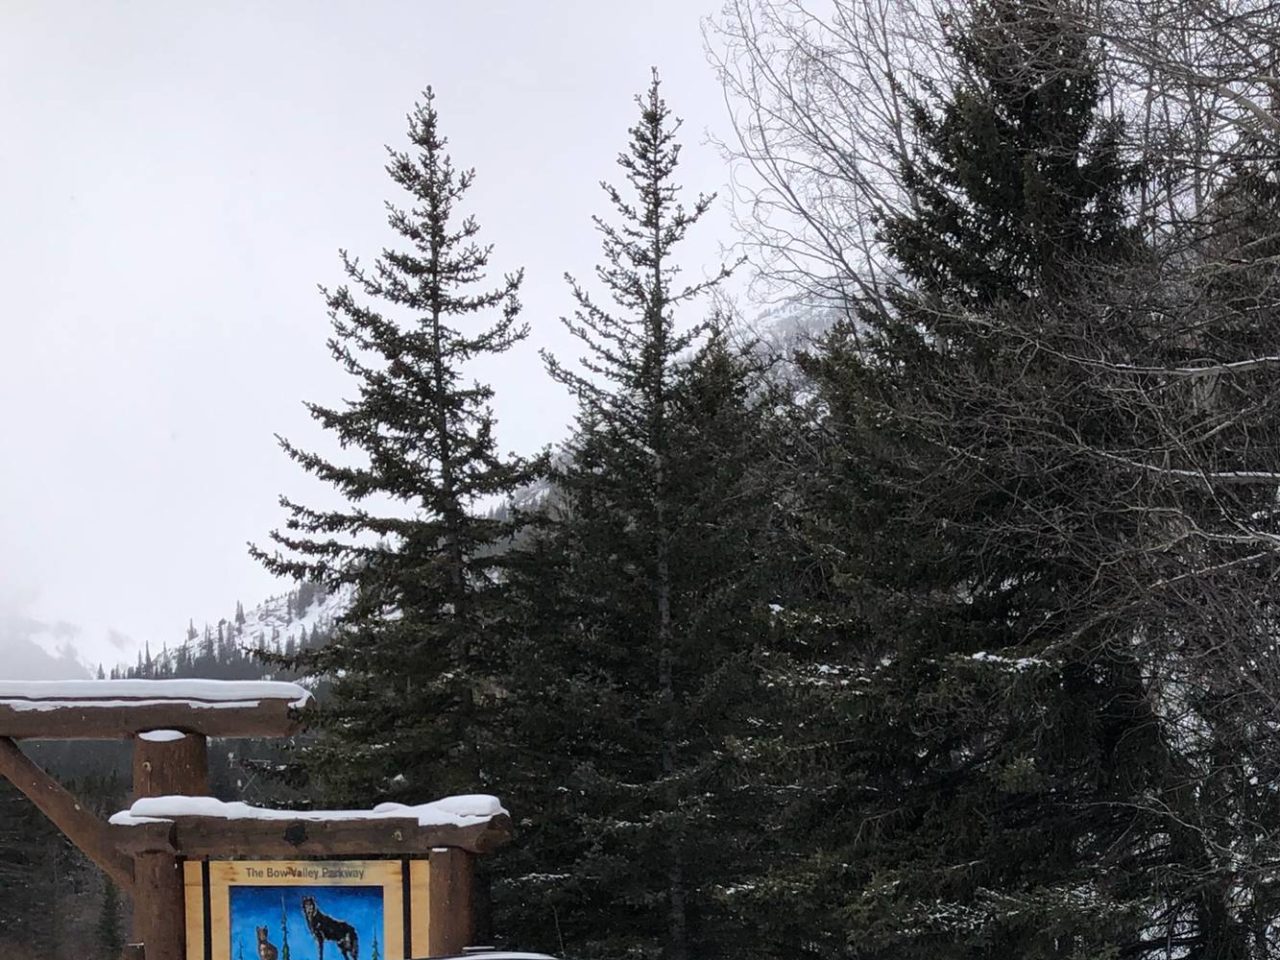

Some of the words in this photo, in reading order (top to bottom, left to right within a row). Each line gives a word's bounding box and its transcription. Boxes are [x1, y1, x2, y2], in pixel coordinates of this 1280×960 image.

[246, 867, 264, 878] The
[266, 867, 288, 878] Bow
[290, 867, 319, 880] Valley
[322, 867, 365, 880] Parkway
